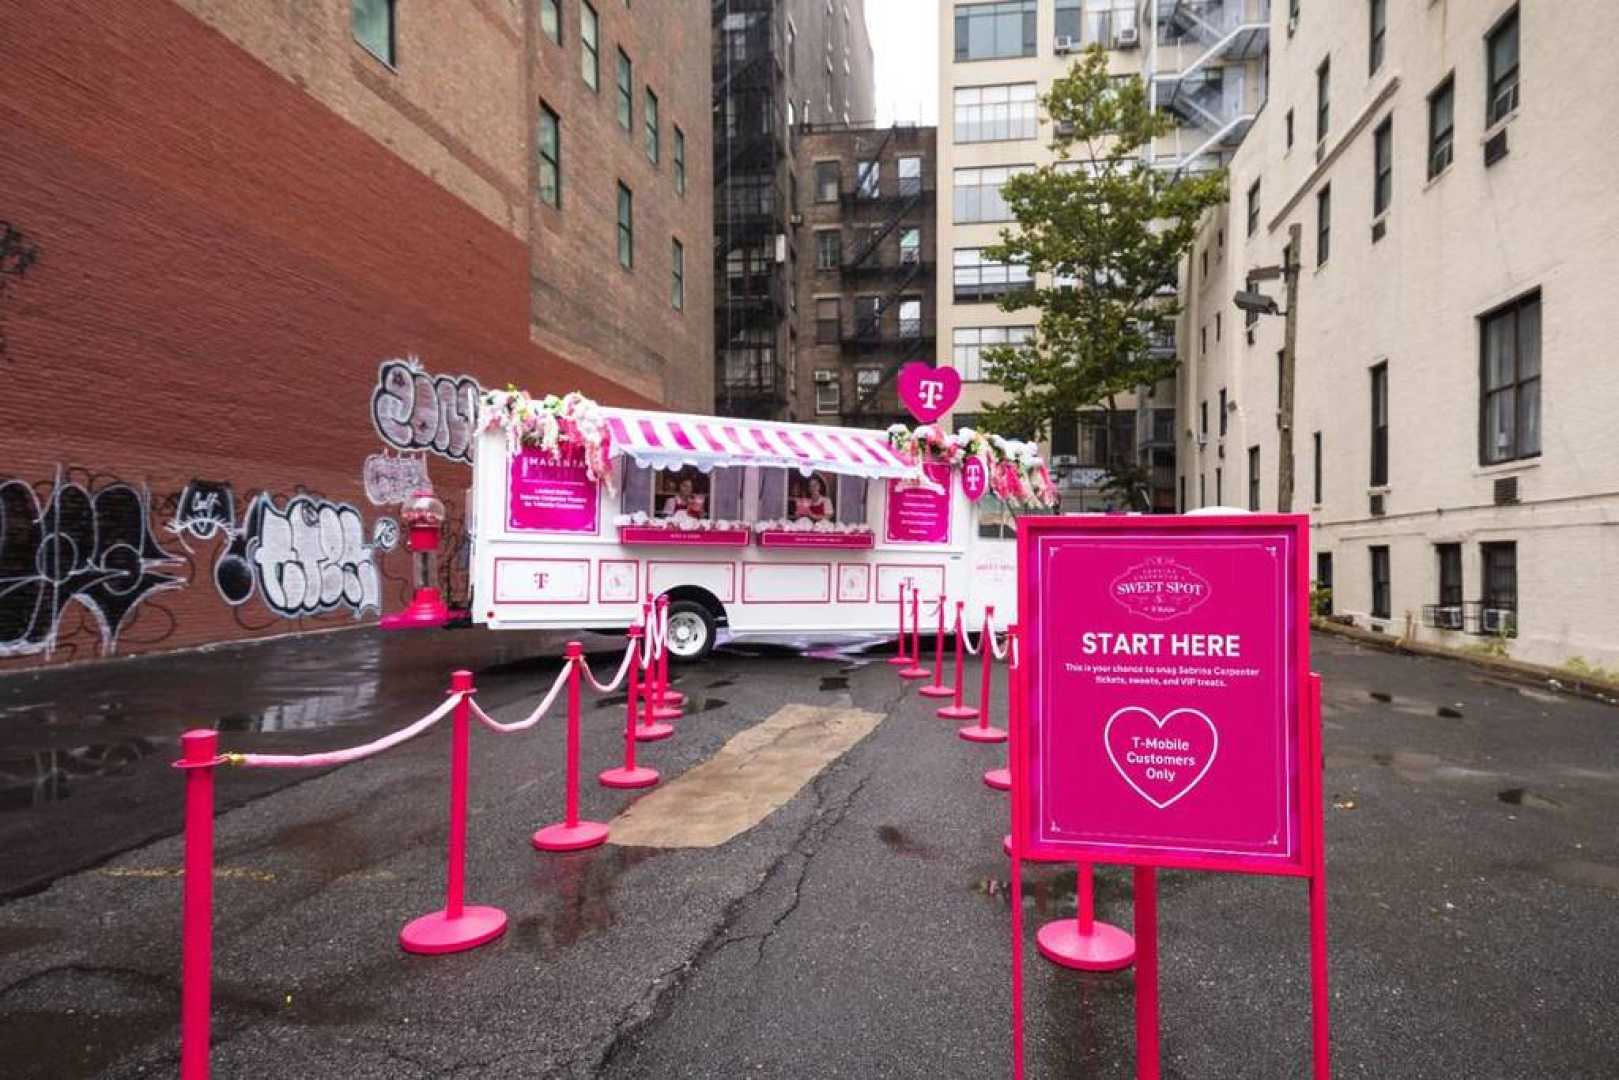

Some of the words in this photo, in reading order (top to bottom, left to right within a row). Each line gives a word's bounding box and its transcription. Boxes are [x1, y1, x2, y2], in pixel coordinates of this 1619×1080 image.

[918, 380, 943, 409] T
[966, 464, 980, 491] T
[533, 572, 549, 589] T
[1117, 581, 1163, 595] SWEET
[1166, 581, 1201, 595] SPOT
[1082, 632, 1164, 655] START
[1171, 634, 1240, 657] HERE
[1065, 663, 1082, 672] This
[1084, 664, 1091, 672] is
[1093, 665, 1110, 674] your
[1113, 665, 1142, 673] chance
[1156, 667, 1176, 676] snag
[1179, 666, 1211, 675] Sabrina
[1214, 667, 1259, 677] Carpenter
[1163, 678, 1178, 686] and
[1181, 678, 1196, 686] VIP
[1198, 679, 1227, 687] treats.
[1132, 737, 1189, 750] T-Mobile
[1127, 751, 1196, 766] Customers
[1146, 767, 1175, 782] Only
